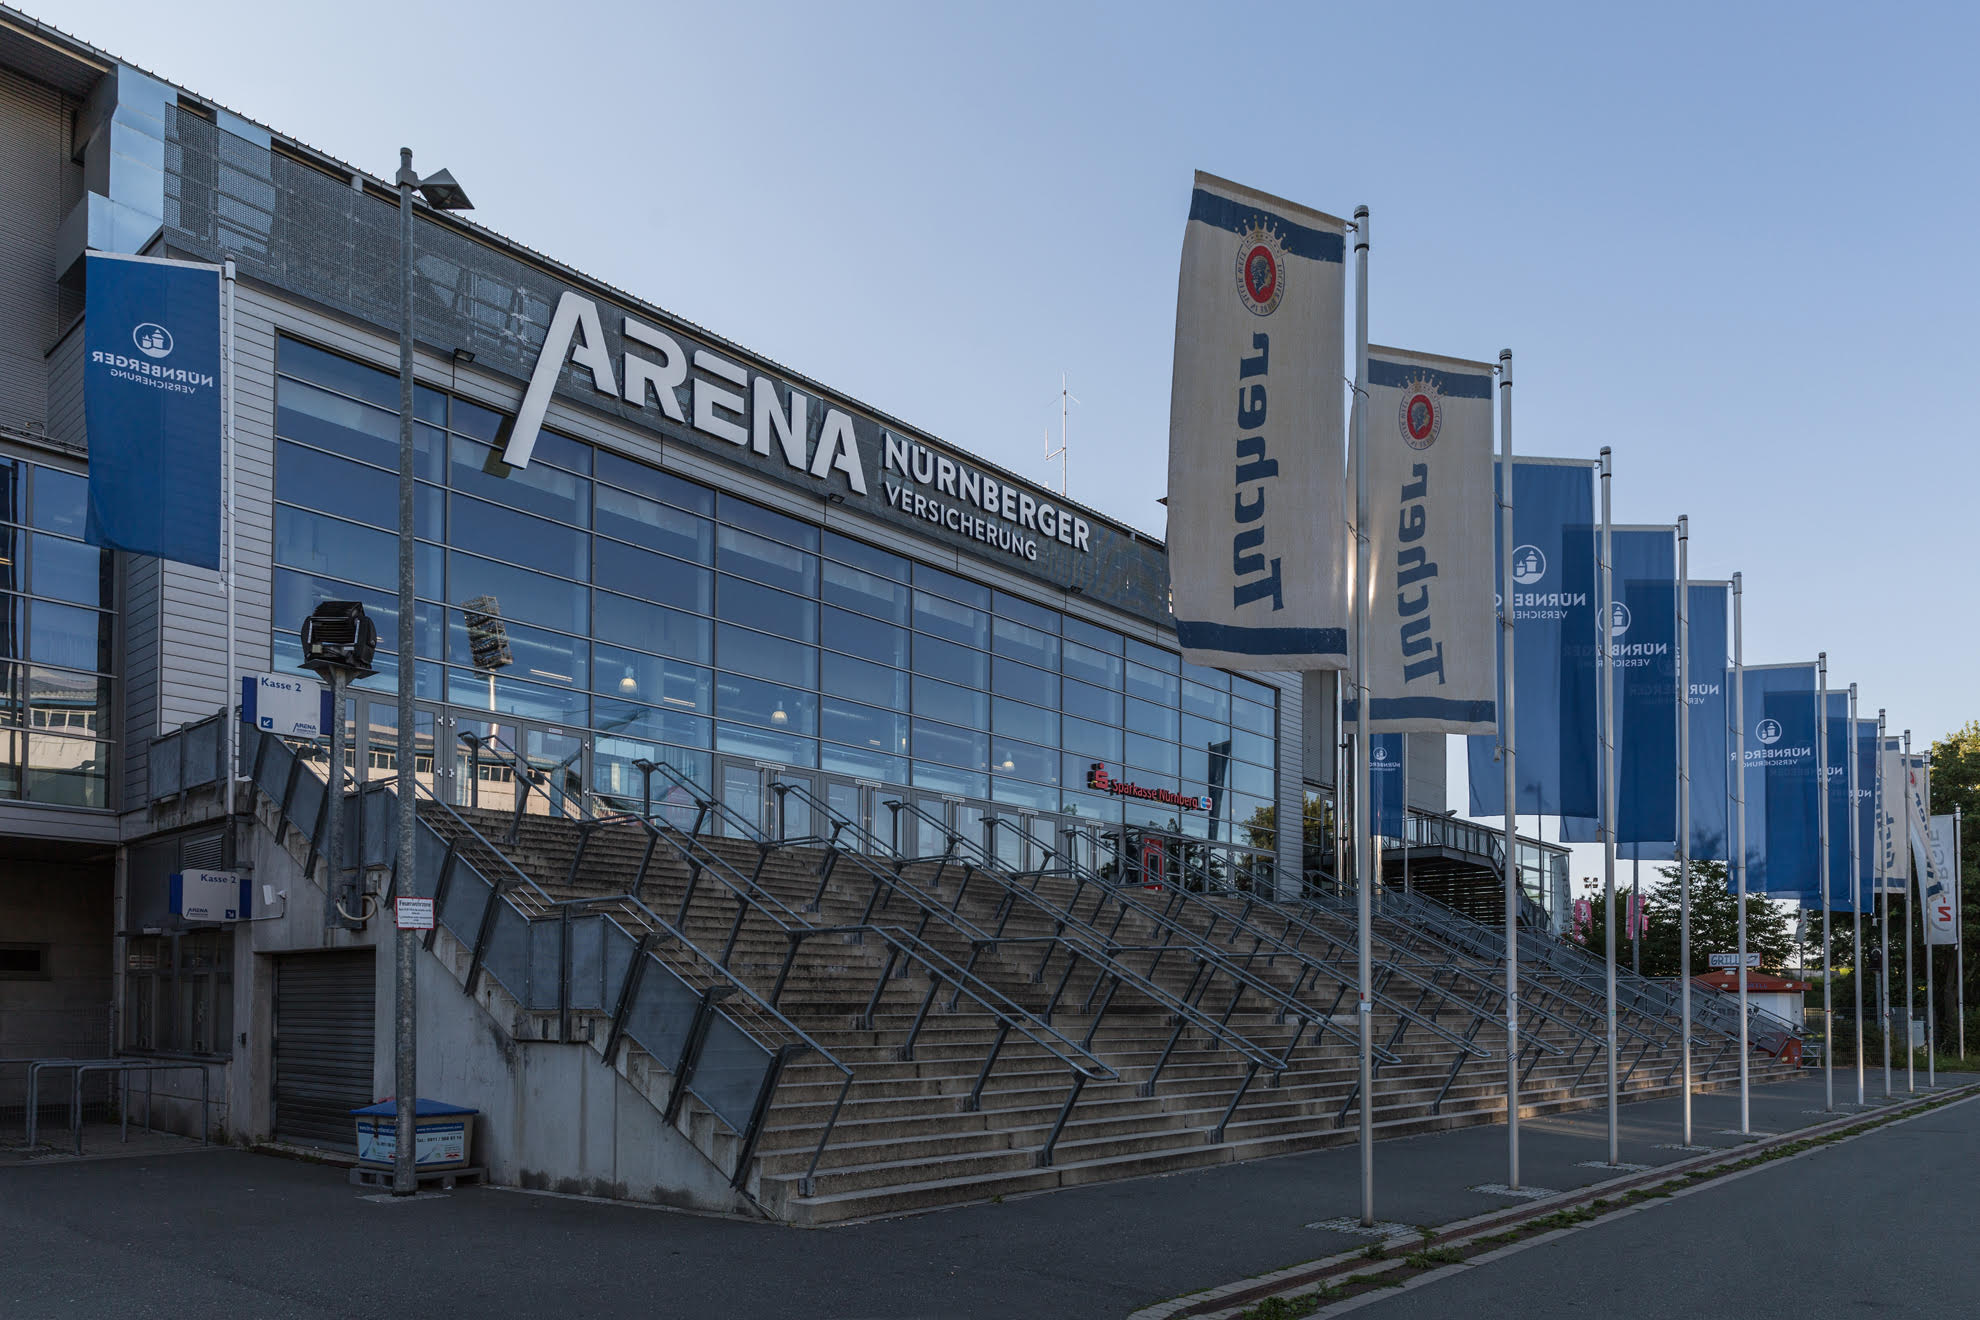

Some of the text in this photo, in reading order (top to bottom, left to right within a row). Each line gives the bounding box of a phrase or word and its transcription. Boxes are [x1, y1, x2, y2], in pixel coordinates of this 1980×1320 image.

[501, 290, 868, 496] ARENA
[884, 431, 1090, 552] NÜRNBERGER
[884, 480, 1037, 561] VERSICHERUNG
[261, 677, 302, 692] Kasse 2
[293, 722, 317, 733] ARENA
[1111, 779, 1198, 810] Sparkasse Nürnberg
[200, 873, 236, 884] Kasse 2
[186, 907, 208, 917] ARENA
[1711, 954, 1740, 966] GRILL
